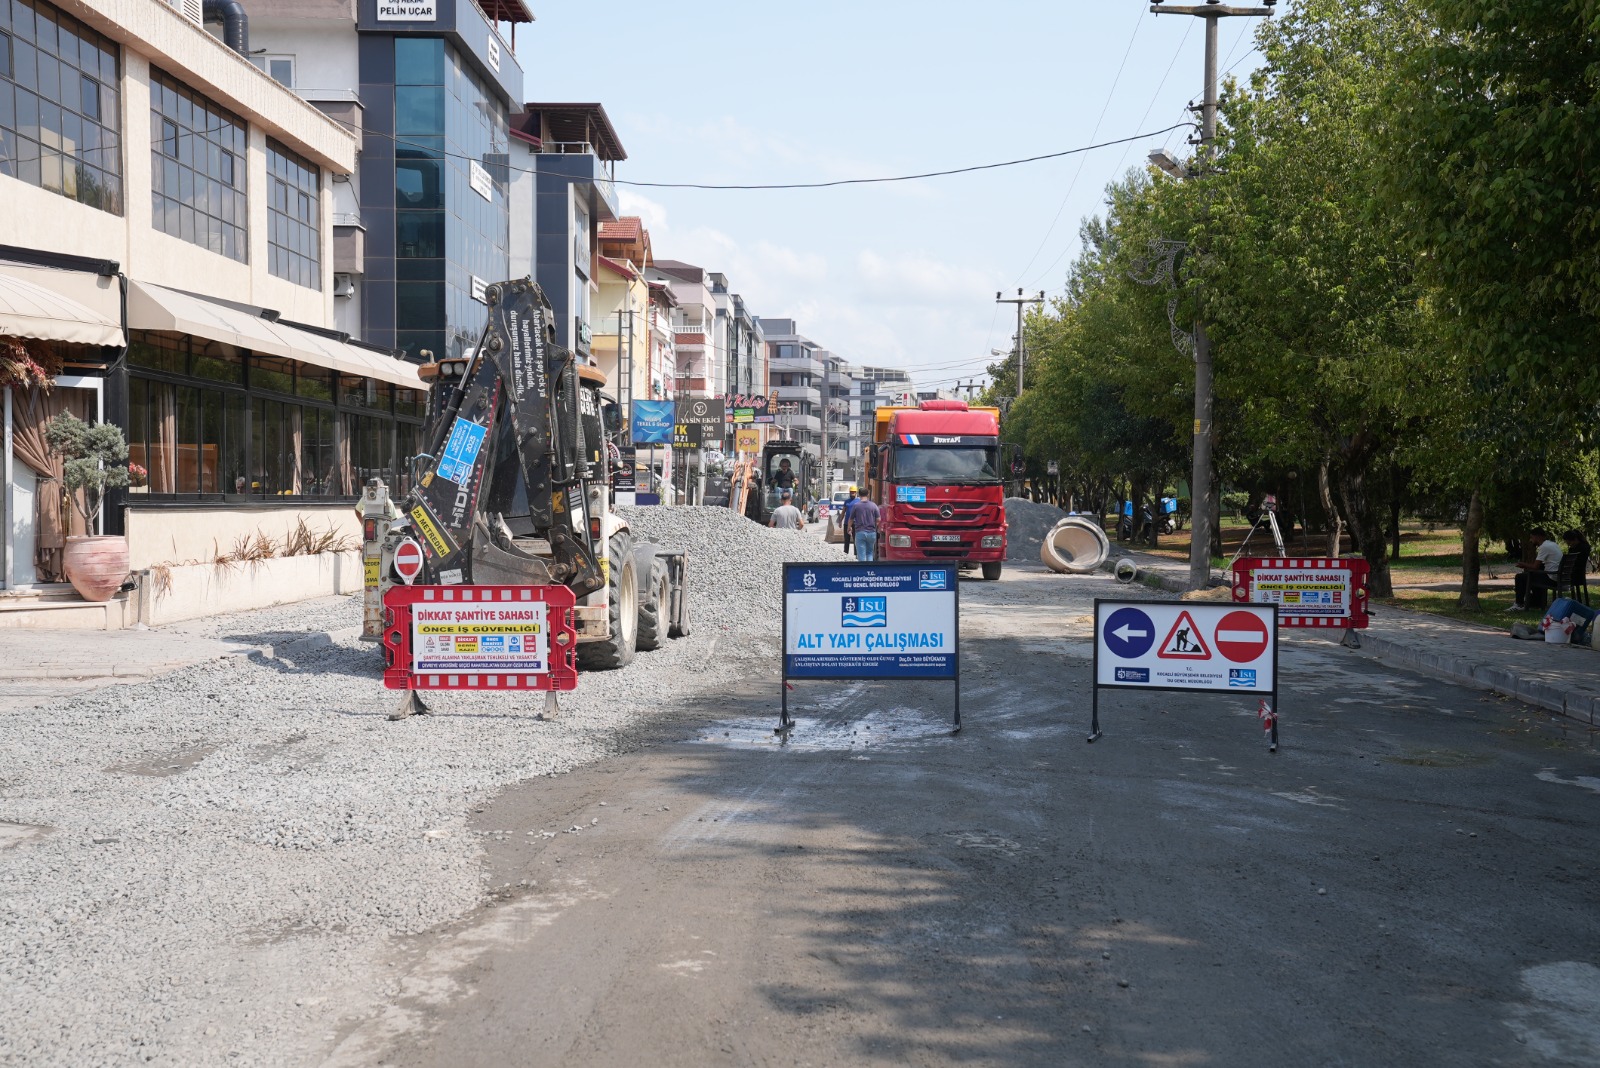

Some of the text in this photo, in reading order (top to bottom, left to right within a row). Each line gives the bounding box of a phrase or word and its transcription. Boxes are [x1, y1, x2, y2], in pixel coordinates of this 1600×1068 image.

[380, 6, 432, 16] PELİN UÇAR
[533, 309, 544, 348] Abartacak
[536, 348, 544, 360] bir
[681, 416, 701, 424] YASİN
[674, 425, 687, 434] TK
[413, 509, 447, 556] 25 METREDEN
[930, 571, 944, 580] İSU
[1257, 573, 1282, 582] DİKKAT
[1284, 573, 1313, 583] ŞANTİYE
[1315, 574, 1341, 582] SAHASI
[860, 599, 884, 611] İSU
[418, 609, 452, 621] DİKKAT
[455, 609, 496, 623] ŞANTİYE
[499, 610, 534, 621] SAHASI
[423, 625, 536, 633] ÖNCE İŞ GÜVENLİĞİ
[798, 632, 943, 651] ALT YAPI ÇALIŞMASI
[1240, 669, 1254, 678] İSU
